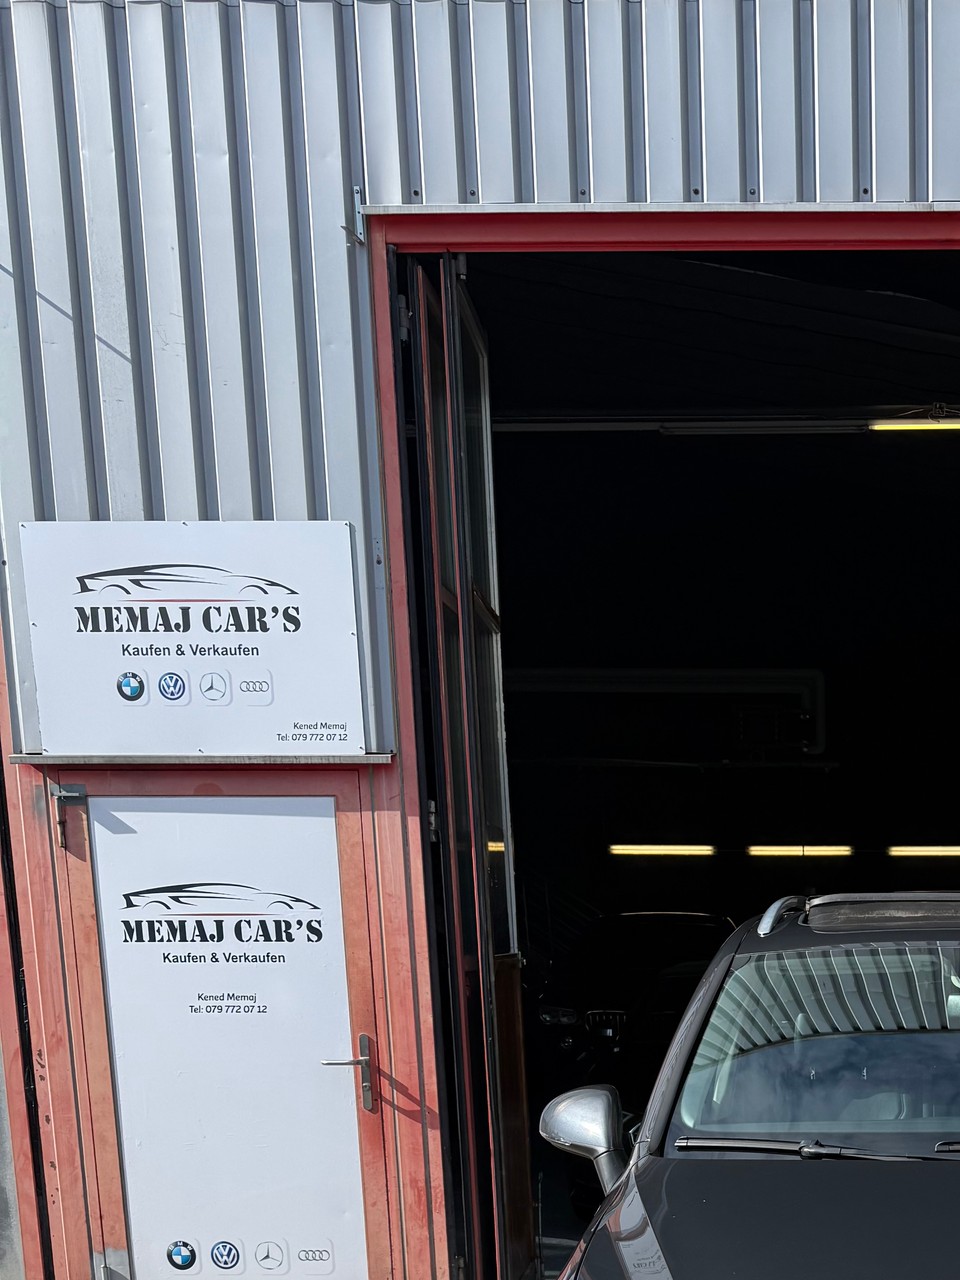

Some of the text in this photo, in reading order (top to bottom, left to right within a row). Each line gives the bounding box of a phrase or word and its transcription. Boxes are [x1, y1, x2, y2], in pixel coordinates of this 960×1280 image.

[74, 606, 301, 632] MEMAJ CAR'S
[122, 644, 259, 656] Kaufen & Verkaufen
[292, 721, 348, 732] Kened Memaj
[276, 733, 348, 741] Tel: 079 772 07 12
[121, 920, 322, 942] MEMAJ CAR'S
[163, 952, 285, 963] Kaufen & Verkaufen
[197, 992, 257, 1004] Kened Memaj
[189, 1004, 268, 1014] Tel: 079 772 07 12
